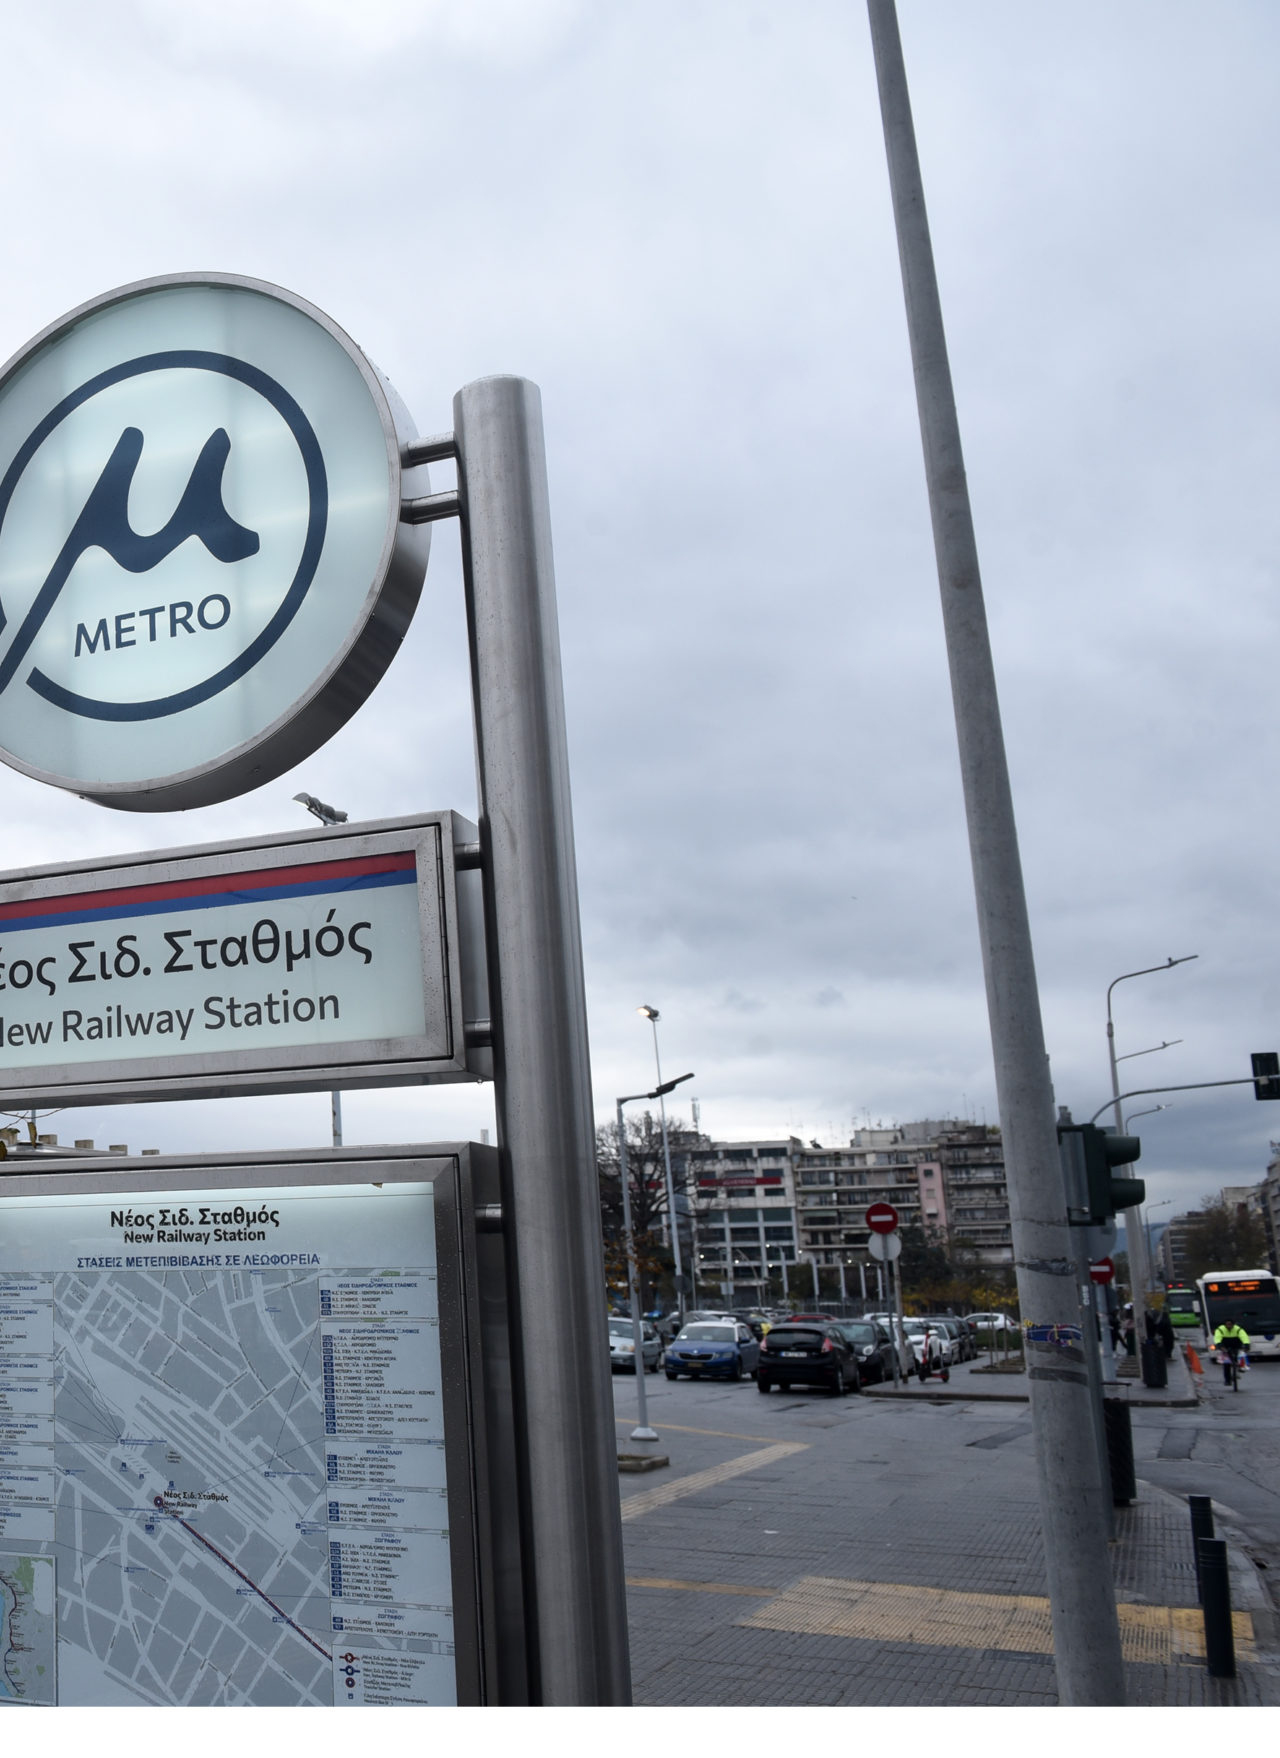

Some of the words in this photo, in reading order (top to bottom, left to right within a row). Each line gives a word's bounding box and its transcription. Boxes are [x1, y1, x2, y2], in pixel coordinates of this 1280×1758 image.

[74, 593, 231, 657] METRO
[67, 935, 152, 983] Σιδ.
[163, 908, 373, 974] Σταθμός
[62, 1004, 195, 1042] Railway
[204, 990, 340, 1030] Station
[110, 1209, 155, 1230] Νέος
[158, 1208, 194, 1226] Σιδ.
[198, 1204, 280, 1228] Σταθμός
[124, 1231, 153, 1243] New
[157, 1229, 211, 1245] Railway
[213, 1228, 266, 1242] Station
[77, 1257, 122, 1268] ΣΤΑΣΕΙΣ
[125, 1254, 222, 1267] ΜΕΤΕΠΙΒΙΒΑΣΗΣ
[225, 1254, 241, 1266] ΣΕ
[243, 1253, 320, 1266] ΛΕΩΦΟΡΕΙΑ
[164, 1491, 181, 1499] Νέος
[198, 1491, 229, 1503] Σταθμός
